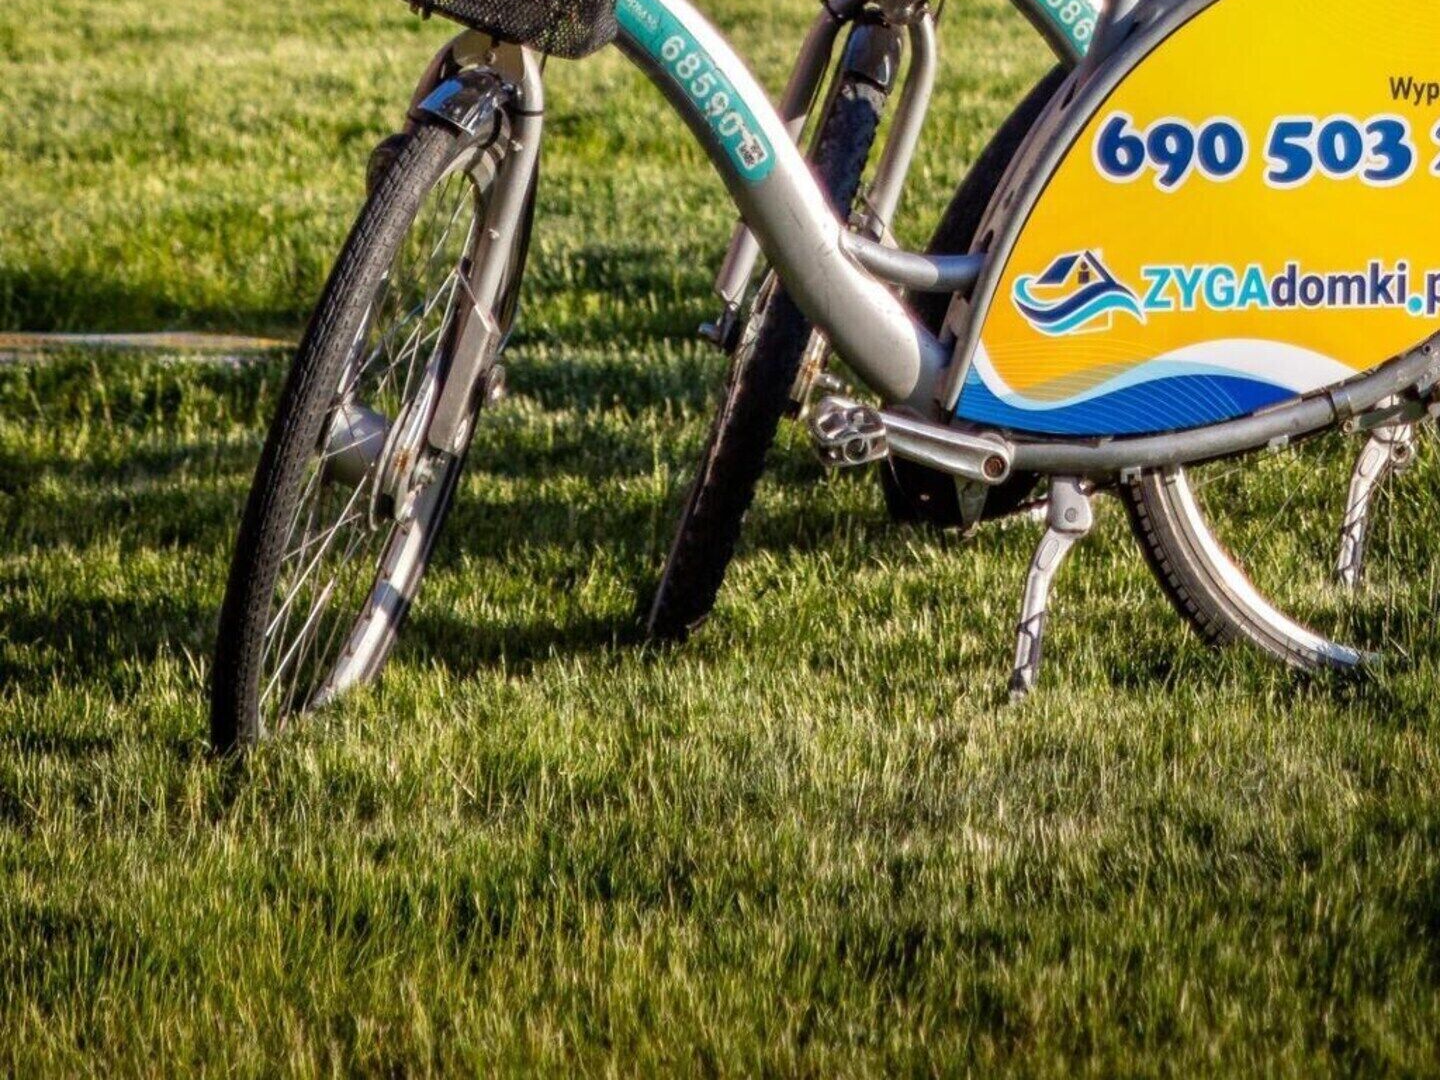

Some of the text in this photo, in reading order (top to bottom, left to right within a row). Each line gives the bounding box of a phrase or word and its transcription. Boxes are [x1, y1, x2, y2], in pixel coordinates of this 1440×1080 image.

[661, 35, 743, 137] 68590
[1096, 114, 1246, 189] 690
[1264, 117, 1416, 185] 503
